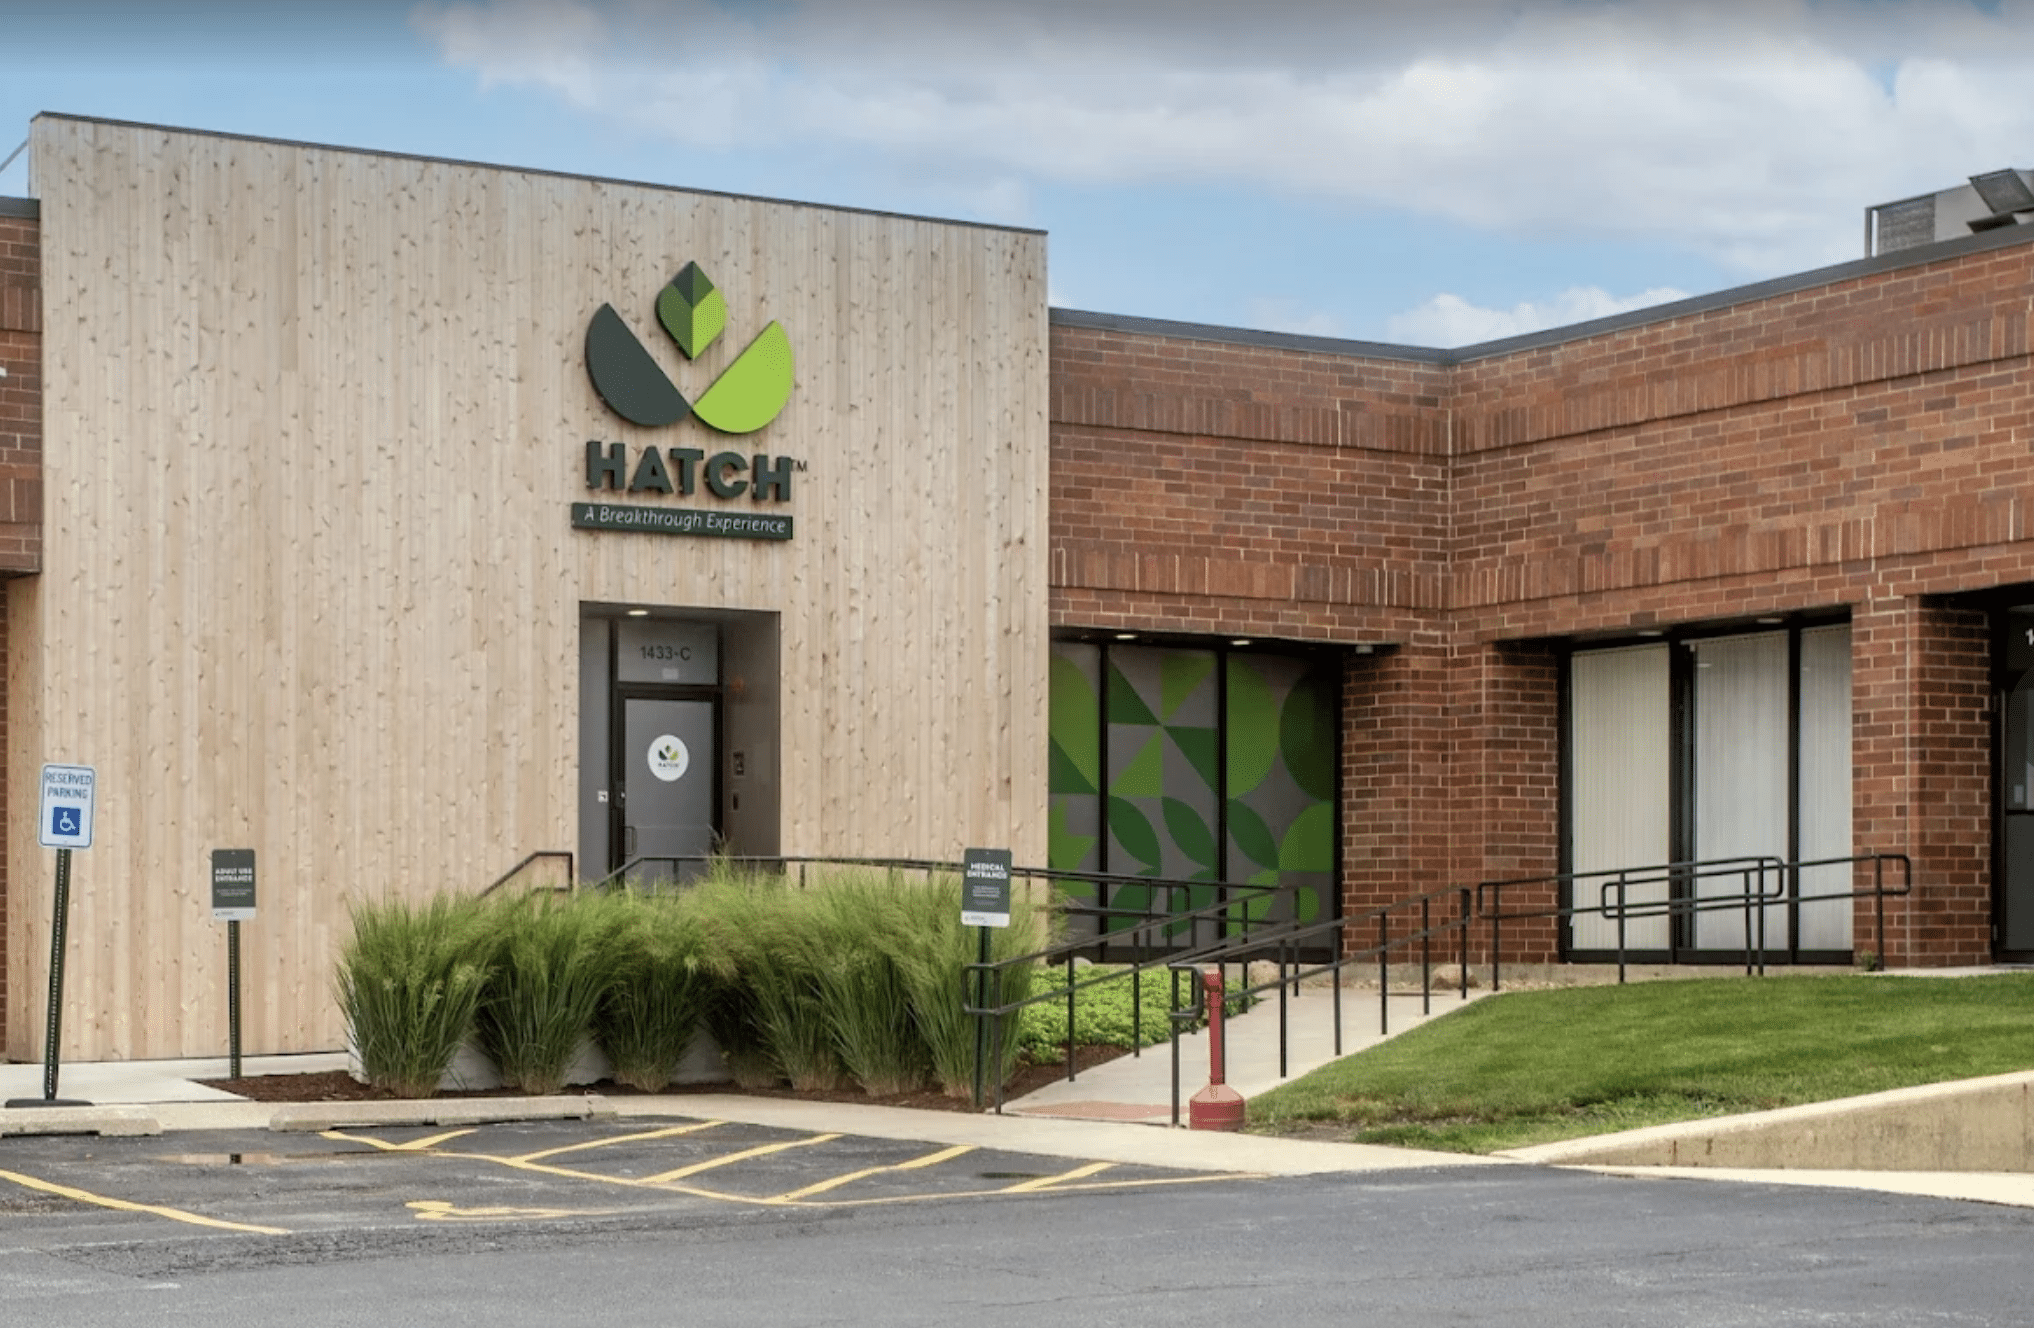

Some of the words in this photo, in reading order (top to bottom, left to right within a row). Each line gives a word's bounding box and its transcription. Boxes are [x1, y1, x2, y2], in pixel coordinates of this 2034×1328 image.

[586, 441, 791, 502] HATCH
[584, 507, 595, 521] A
[600, 506, 702, 531] Breakthrough
[706, 513, 786, 533] Experience
[640, 645, 692, 661] 1433-C
[43, 771, 92, 785] RESERVED
[47, 786, 88, 799] PARKING
[970, 862, 1004, 871] MEDICAL
[215, 874, 253, 882] ENTRANCE
[967, 869, 1007, 879] ENTRANCE
